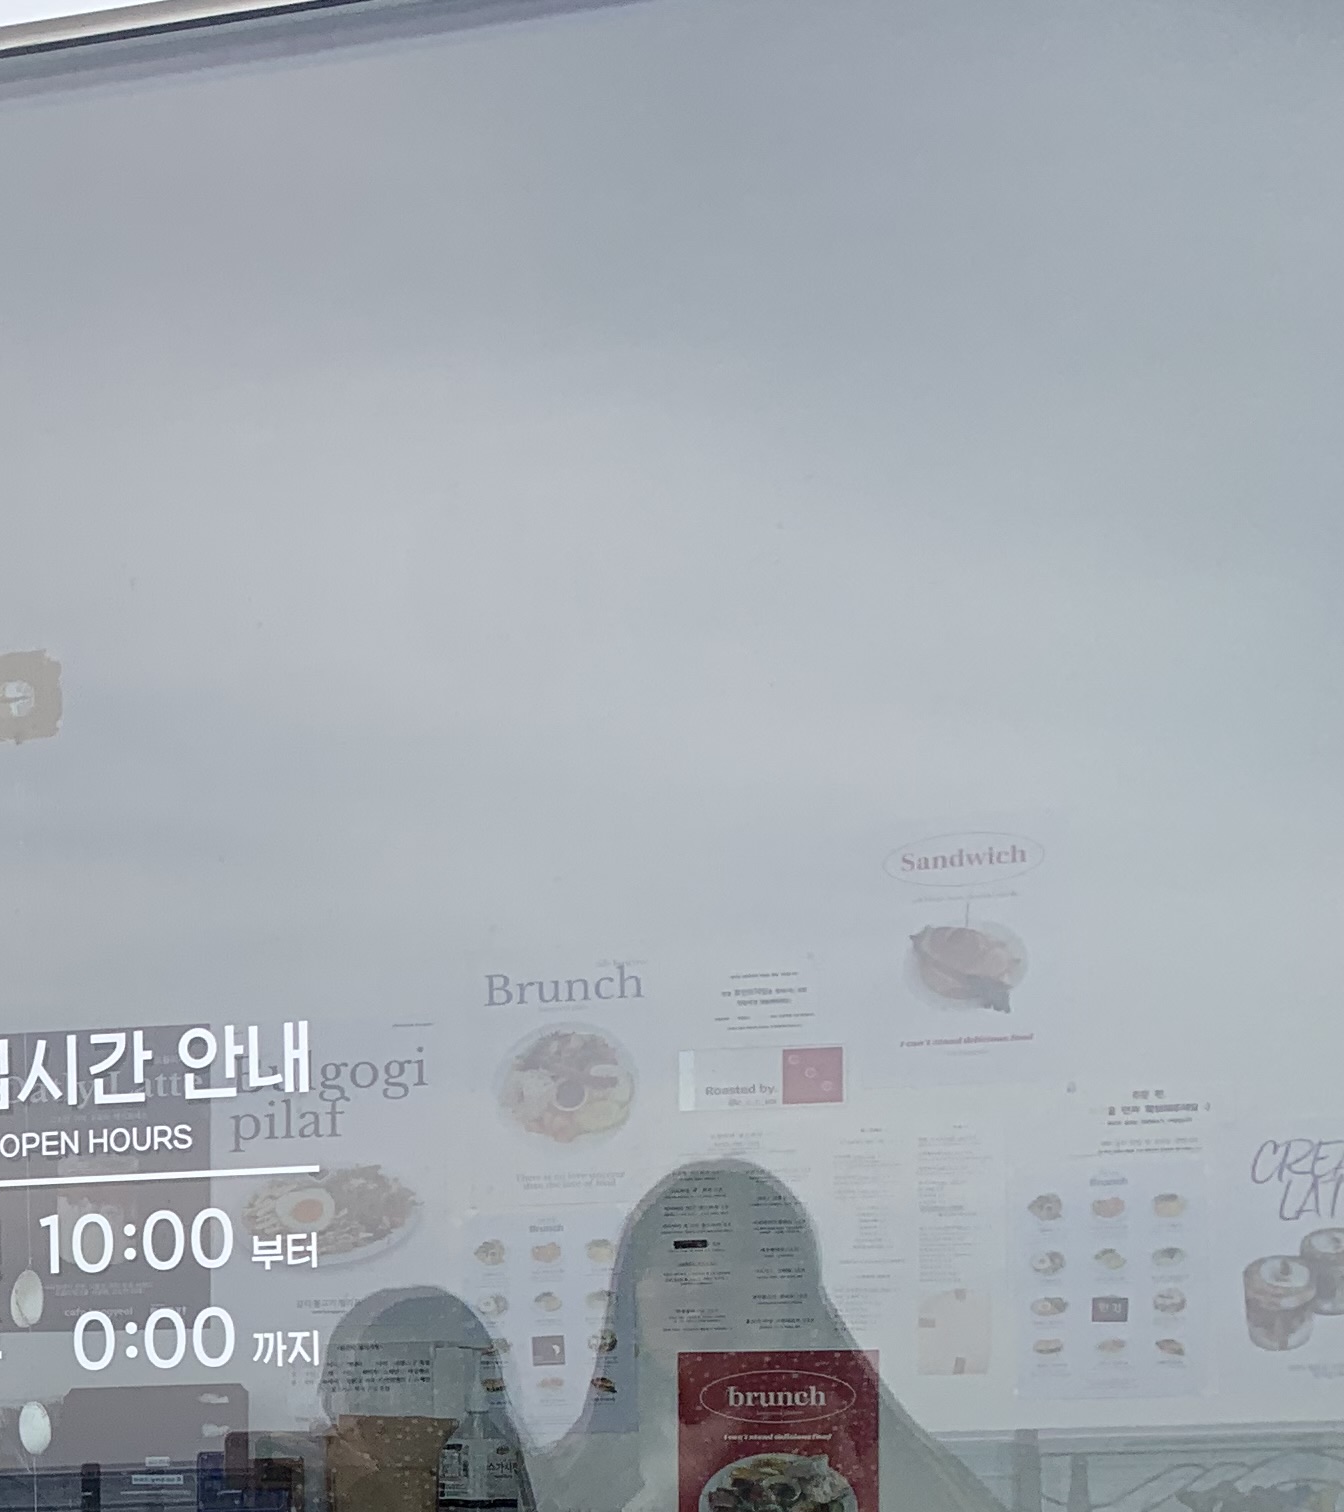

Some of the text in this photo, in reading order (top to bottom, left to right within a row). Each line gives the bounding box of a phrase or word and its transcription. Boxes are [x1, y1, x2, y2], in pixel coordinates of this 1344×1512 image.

[900, 844, 1027, 872] Sandwich
[484, 964, 645, 1007] Brunch
[177, 1020, 311, 1101] 안내
[0, 1124, 193, 1159] OPEN HOURS
[229, 1097, 348, 1152] pilaf
[39, 1206, 235, 1276] 10:00
[251, 1231, 319, 1271] 부터
[73, 1306, 236, 1372] 0:00
[252, 1330, 320, 1368] 까지
[726, 1386, 826, 1408] brunch
